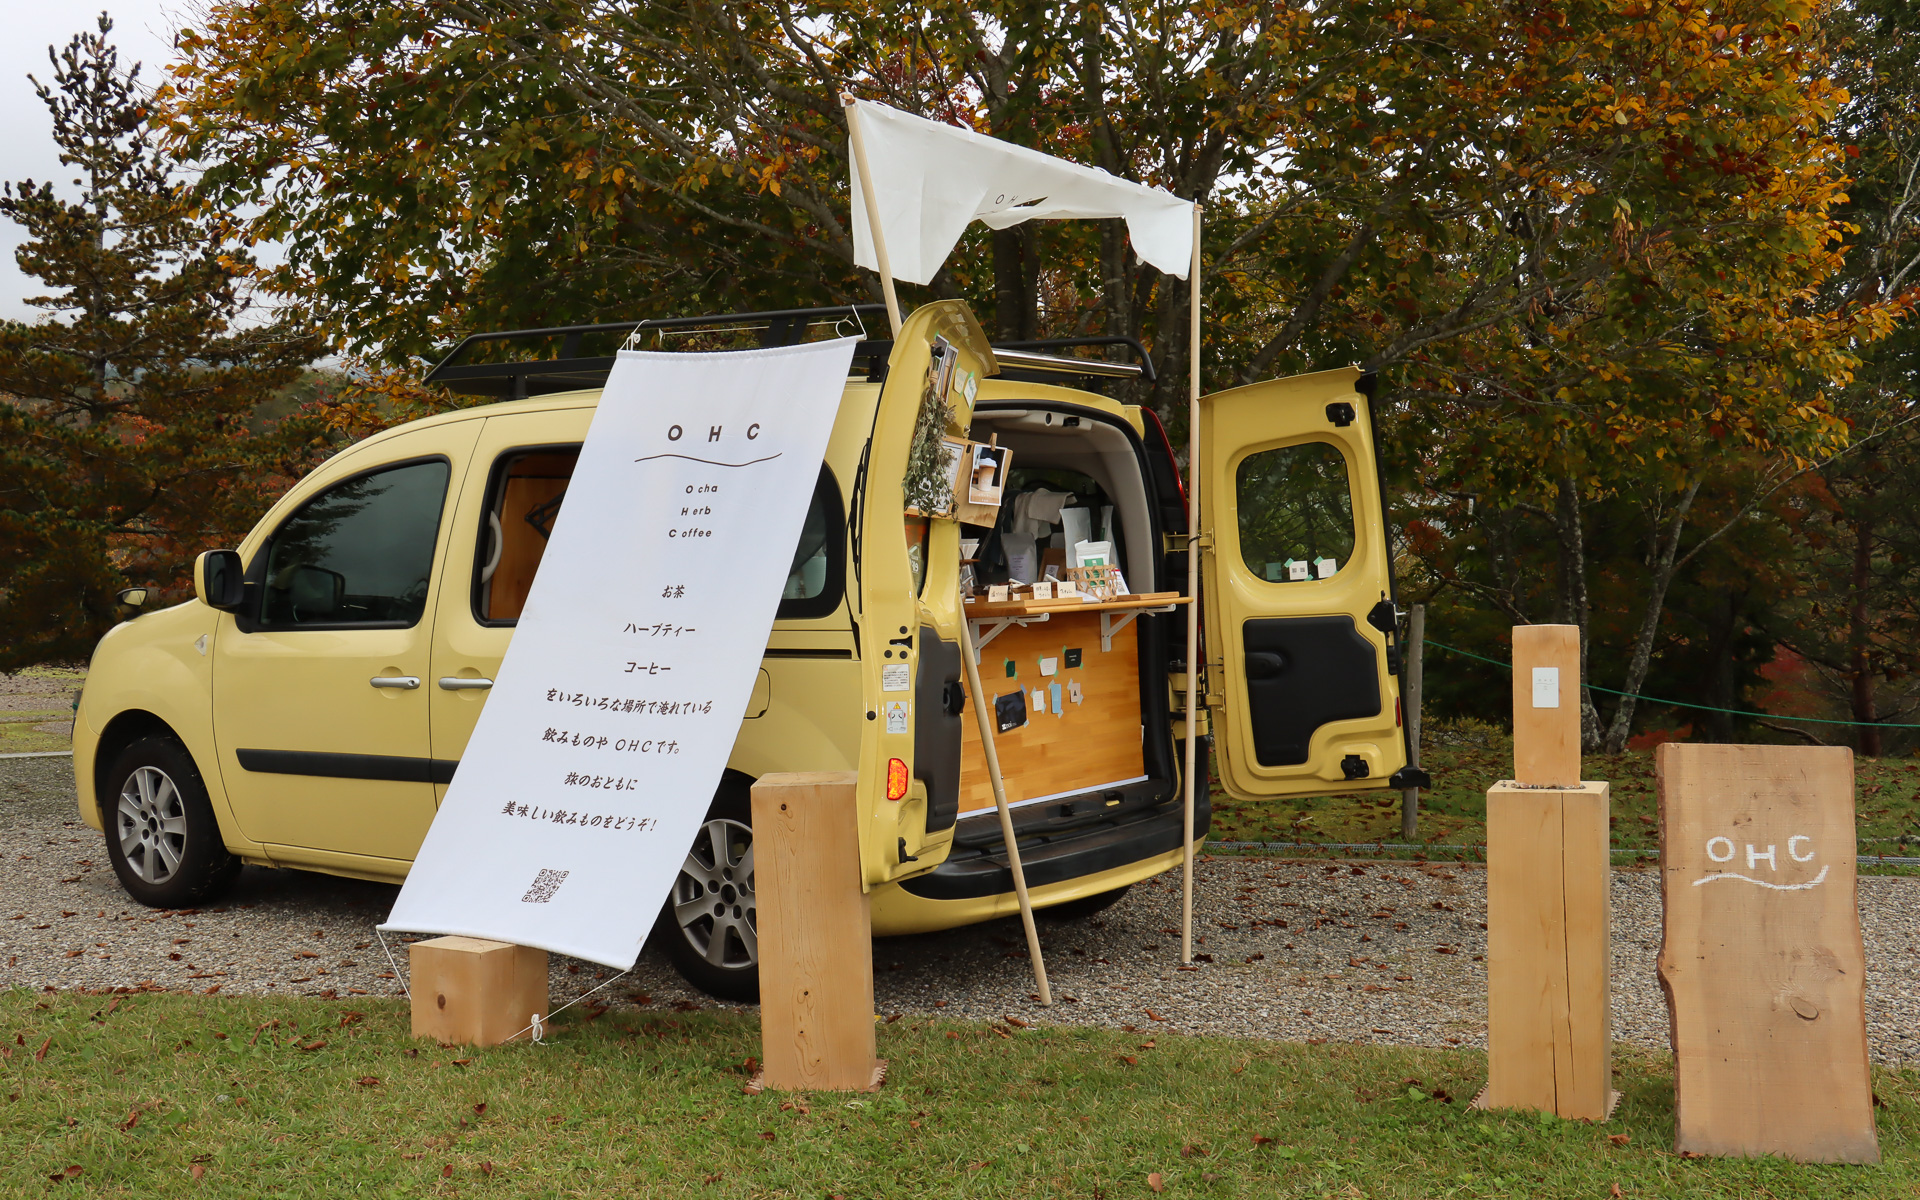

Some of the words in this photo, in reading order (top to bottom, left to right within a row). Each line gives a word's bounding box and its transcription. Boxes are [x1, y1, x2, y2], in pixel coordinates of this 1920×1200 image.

[667, 422, 761, 443] OHC
[686, 483, 719, 495] Ocha
[680, 506, 712, 517] Herb
[668, 528, 712, 539] Coffee
[661, 584, 686, 599] お茶
[623, 622, 696, 638] ハーブティー
[623, 661, 672, 676] コーヒー
[546, 687, 713, 716] をいろいろな場所で淹れている
[564, 771, 639, 791] 旅のおともに
[1705, 834, 1815, 872] OHC
